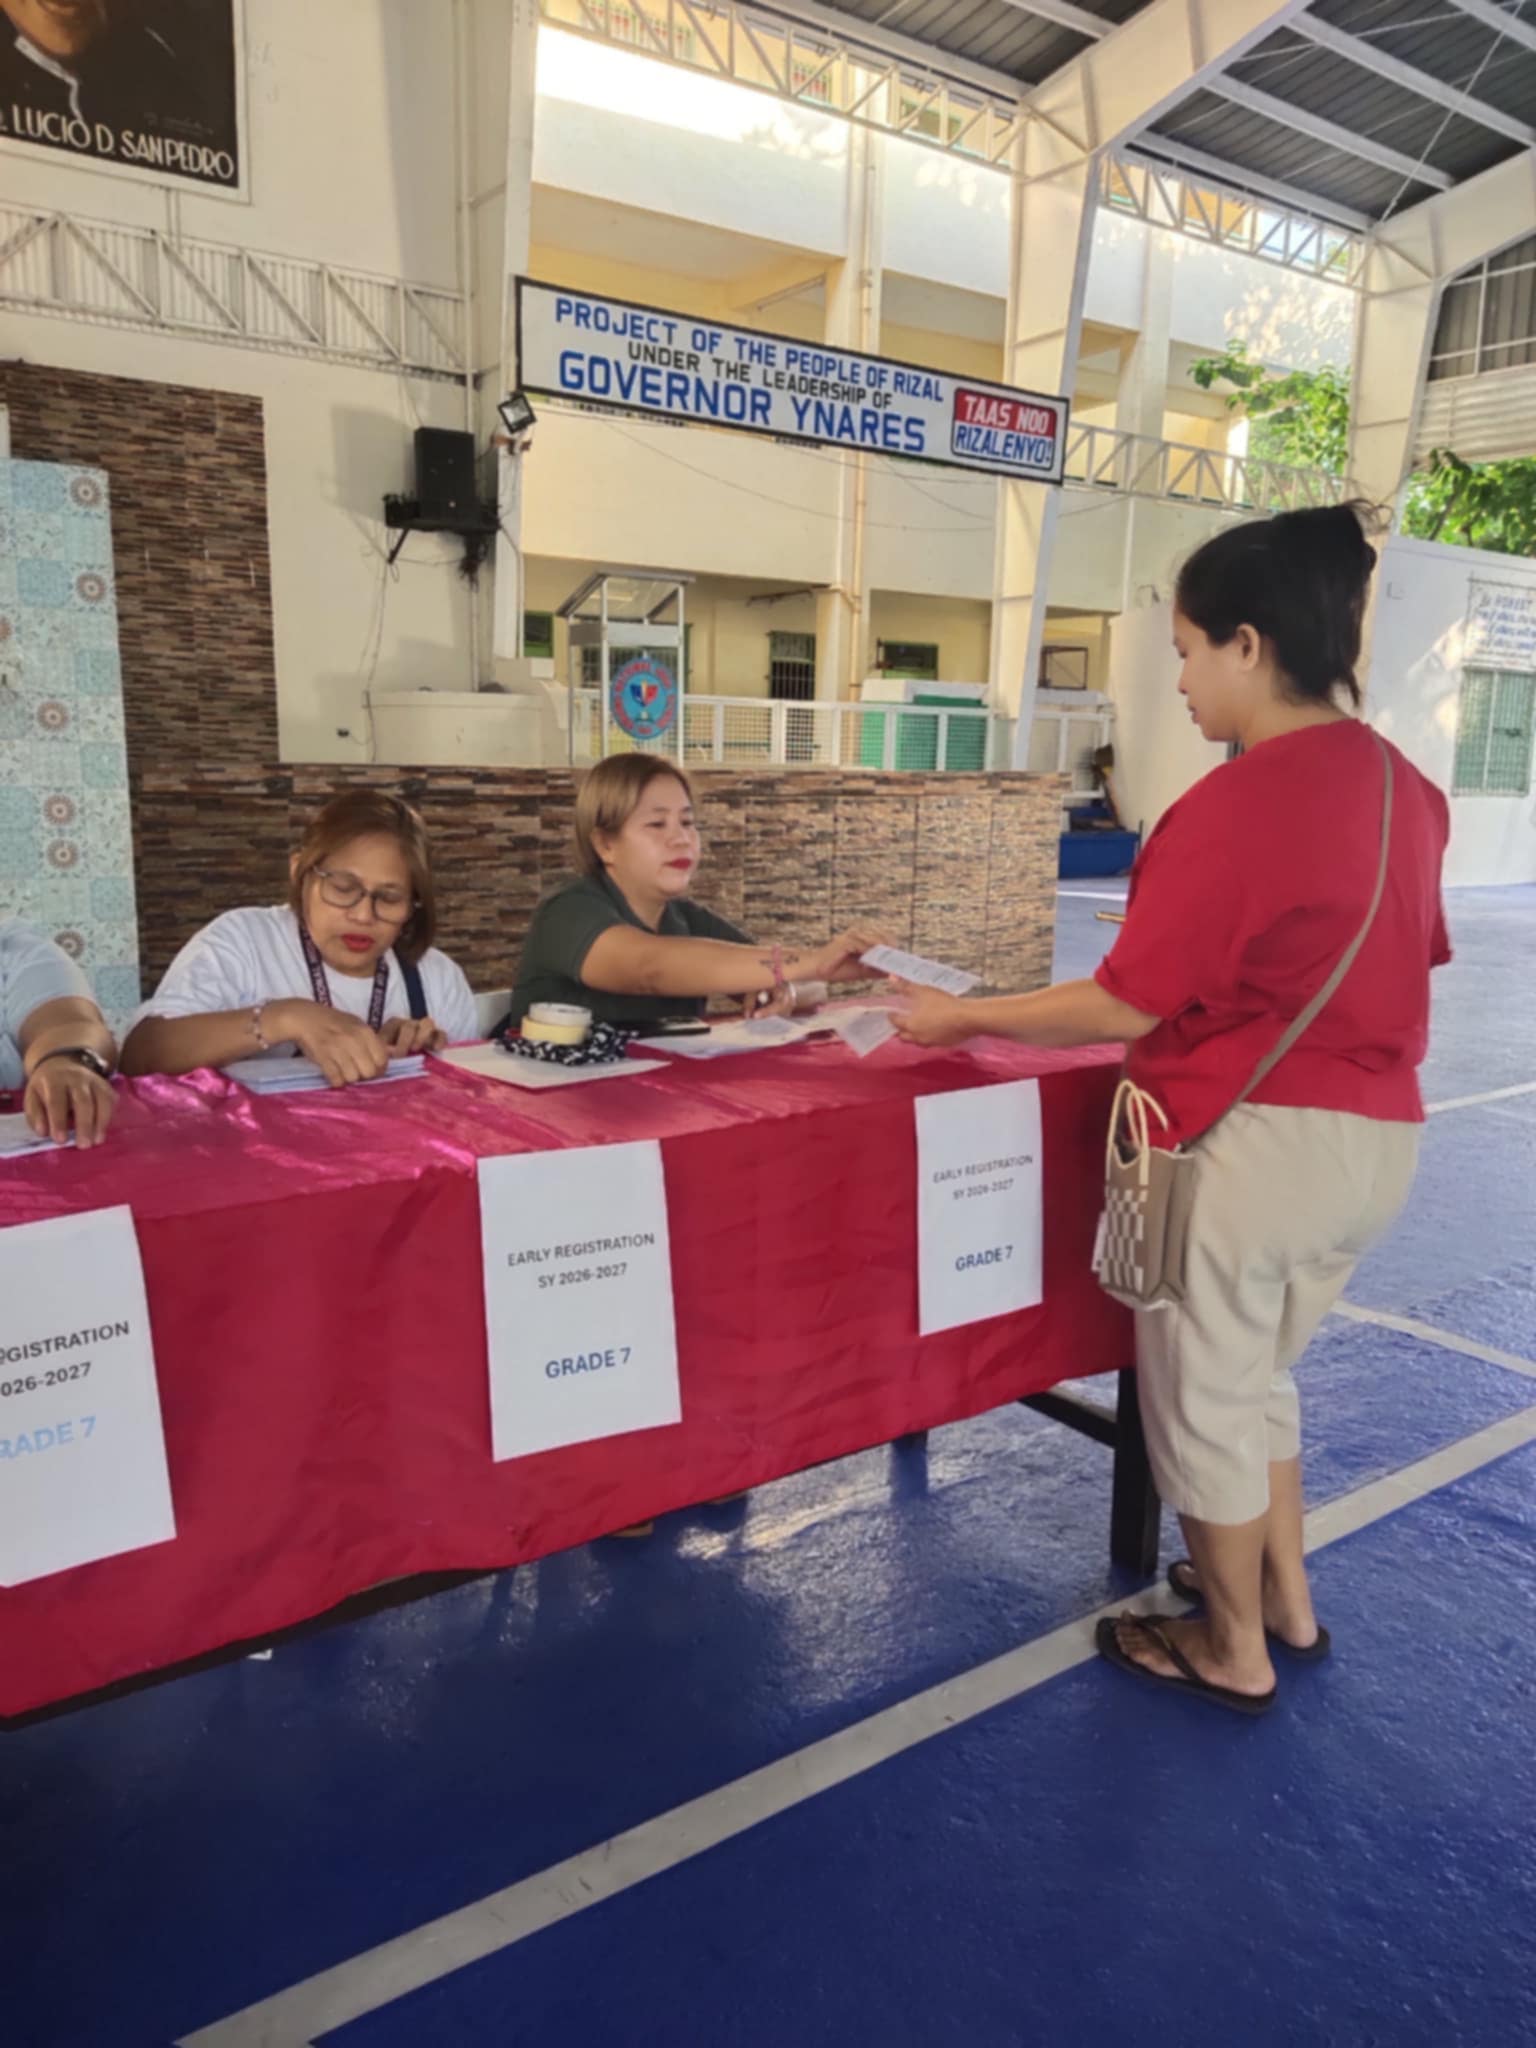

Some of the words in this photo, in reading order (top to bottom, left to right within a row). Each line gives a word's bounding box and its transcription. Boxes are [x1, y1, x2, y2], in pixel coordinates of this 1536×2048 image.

[12, 104, 91, 148] LUCIO
[556, 297, 677, 345] PROJECT
[692, 328, 722, 354] OF
[734, 337, 777, 367] THE
[786, 348, 860, 384] PEOPLE
[866, 365, 888, 389] OF
[893, 371, 943, 402] RIZAL
[628, 341, 699, 373] UNDER
[712, 357, 751, 383] THE
[763, 368, 866, 405] LEADERSHIP
[872, 391, 893, 409] OF
[559, 349, 771, 426] GOVERNOR
[791, 395, 926, 453] YNARES
[965, 395, 1012, 428] TAAS
[1016, 405, 1050, 434] NOO
[955, 425, 1054, 463] RIZALENYO!
[933, 1168, 963, 1184] EARLY
[965, 1154, 1033, 1176] REGISTRATION
[507, 1247, 551, 1267] EARLY
[554, 1232, 655, 1260] REGISTRATION
[954, 1247, 1002, 1272] GRADE
[1005, 1244, 1014, 1260] 7
[537, 1273, 556, 1289] SY
[559, 1261, 628, 1286] 2026-2027
[545, 1349, 616, 1379] GRADE
[618, 1346, 631, 1365] 7
[79, 1414, 97, 1439] 7
